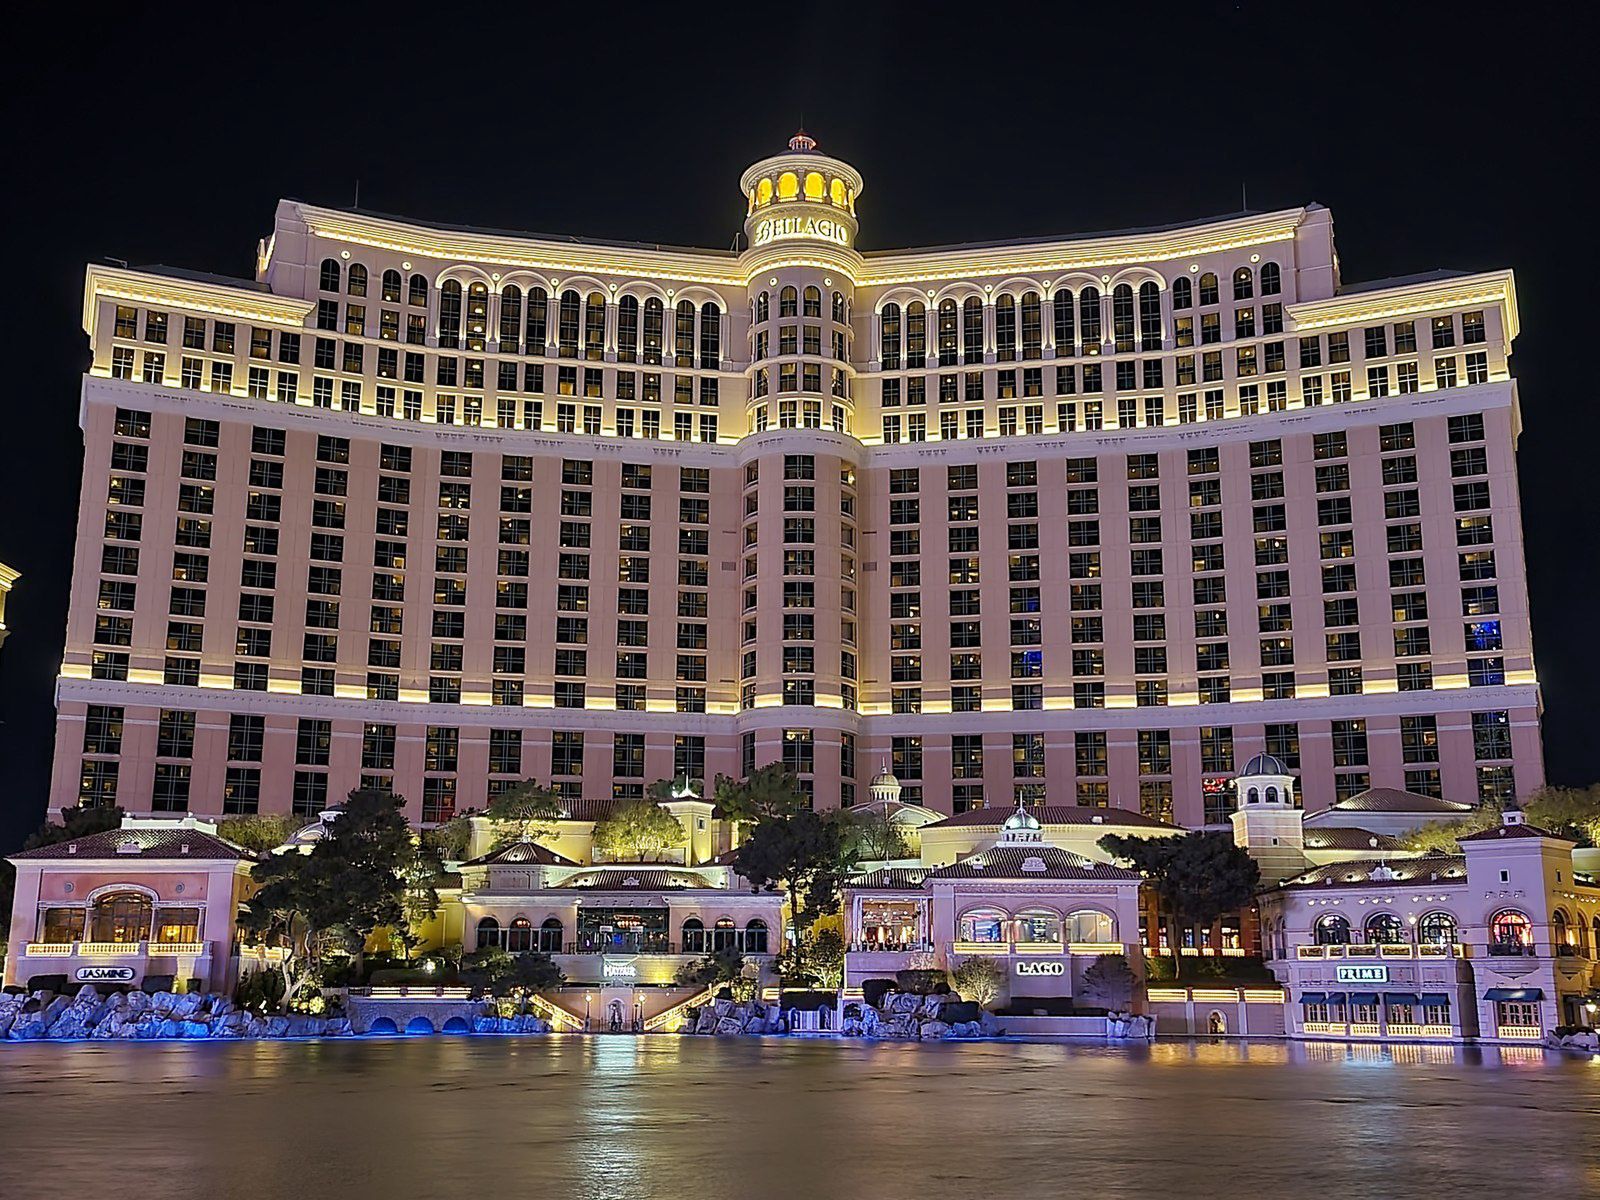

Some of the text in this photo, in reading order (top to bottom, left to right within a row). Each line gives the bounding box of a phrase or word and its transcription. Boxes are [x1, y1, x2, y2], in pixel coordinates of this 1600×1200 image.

[755, 217, 849, 244] BELLAGIO
[81, 969, 130, 978] JASMINE
[1018, 963, 1063, 974] LAGO
[1341, 969, 1382, 979] PRIME
